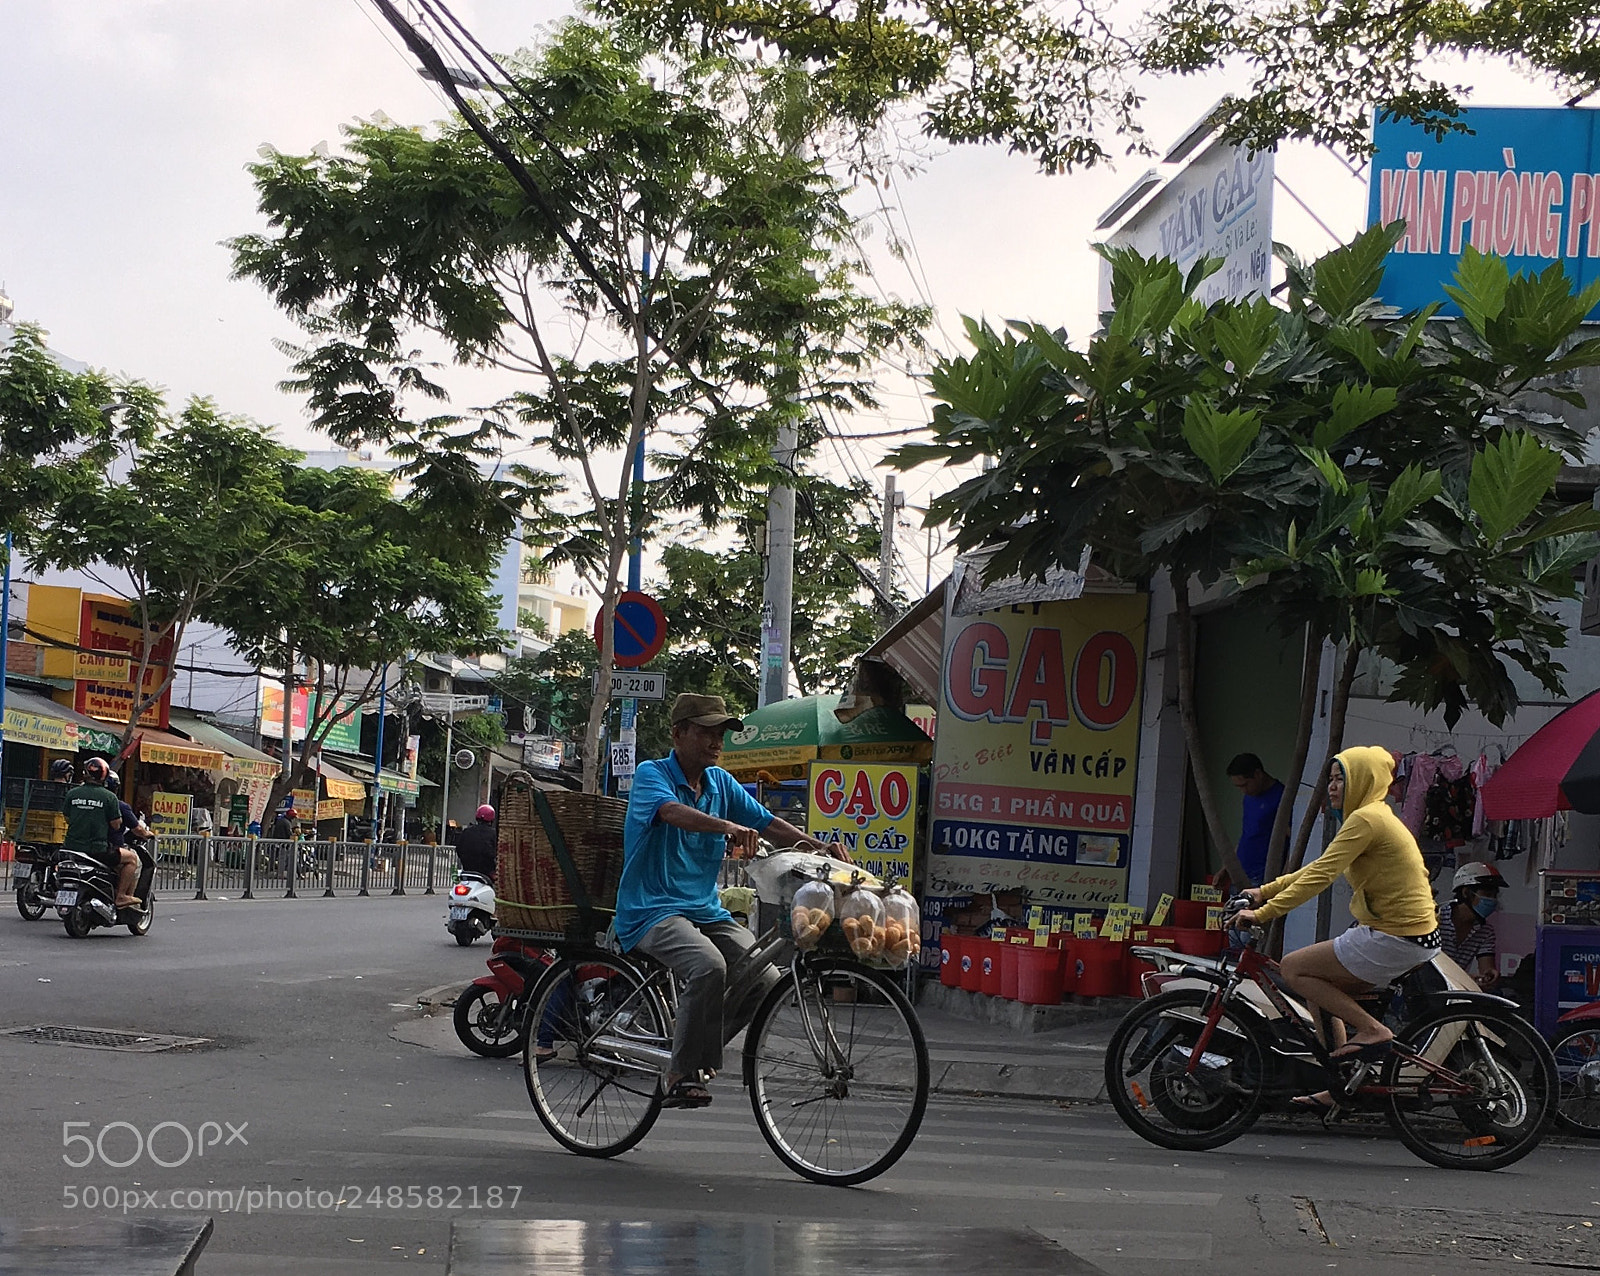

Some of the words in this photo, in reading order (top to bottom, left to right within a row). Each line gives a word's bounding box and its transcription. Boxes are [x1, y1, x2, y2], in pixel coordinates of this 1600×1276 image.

[1380, 151, 1447, 255] VĂN
[1449, 147, 1564, 259] PHÒNG
[944, 622, 1138, 746] GẠO
[613, 748, 630, 765] 285
[1029, 750, 1076, 775] VĂN
[1082, 748, 1127, 779] CẤP
[814, 769, 911, 830] GẠO
[938, 793, 983, 812] 5KG
[991, 797, 1001, 813] 1
[1010, 793, 1073, 820] PHẦN
[1080, 802, 1126, 823] QUÀ
[813, 827, 858, 850] VĂN
[864, 826, 909, 853] CẤP
[942, 827, 1000, 851] 10KG
[1006, 829, 1069, 859] TẶNG
